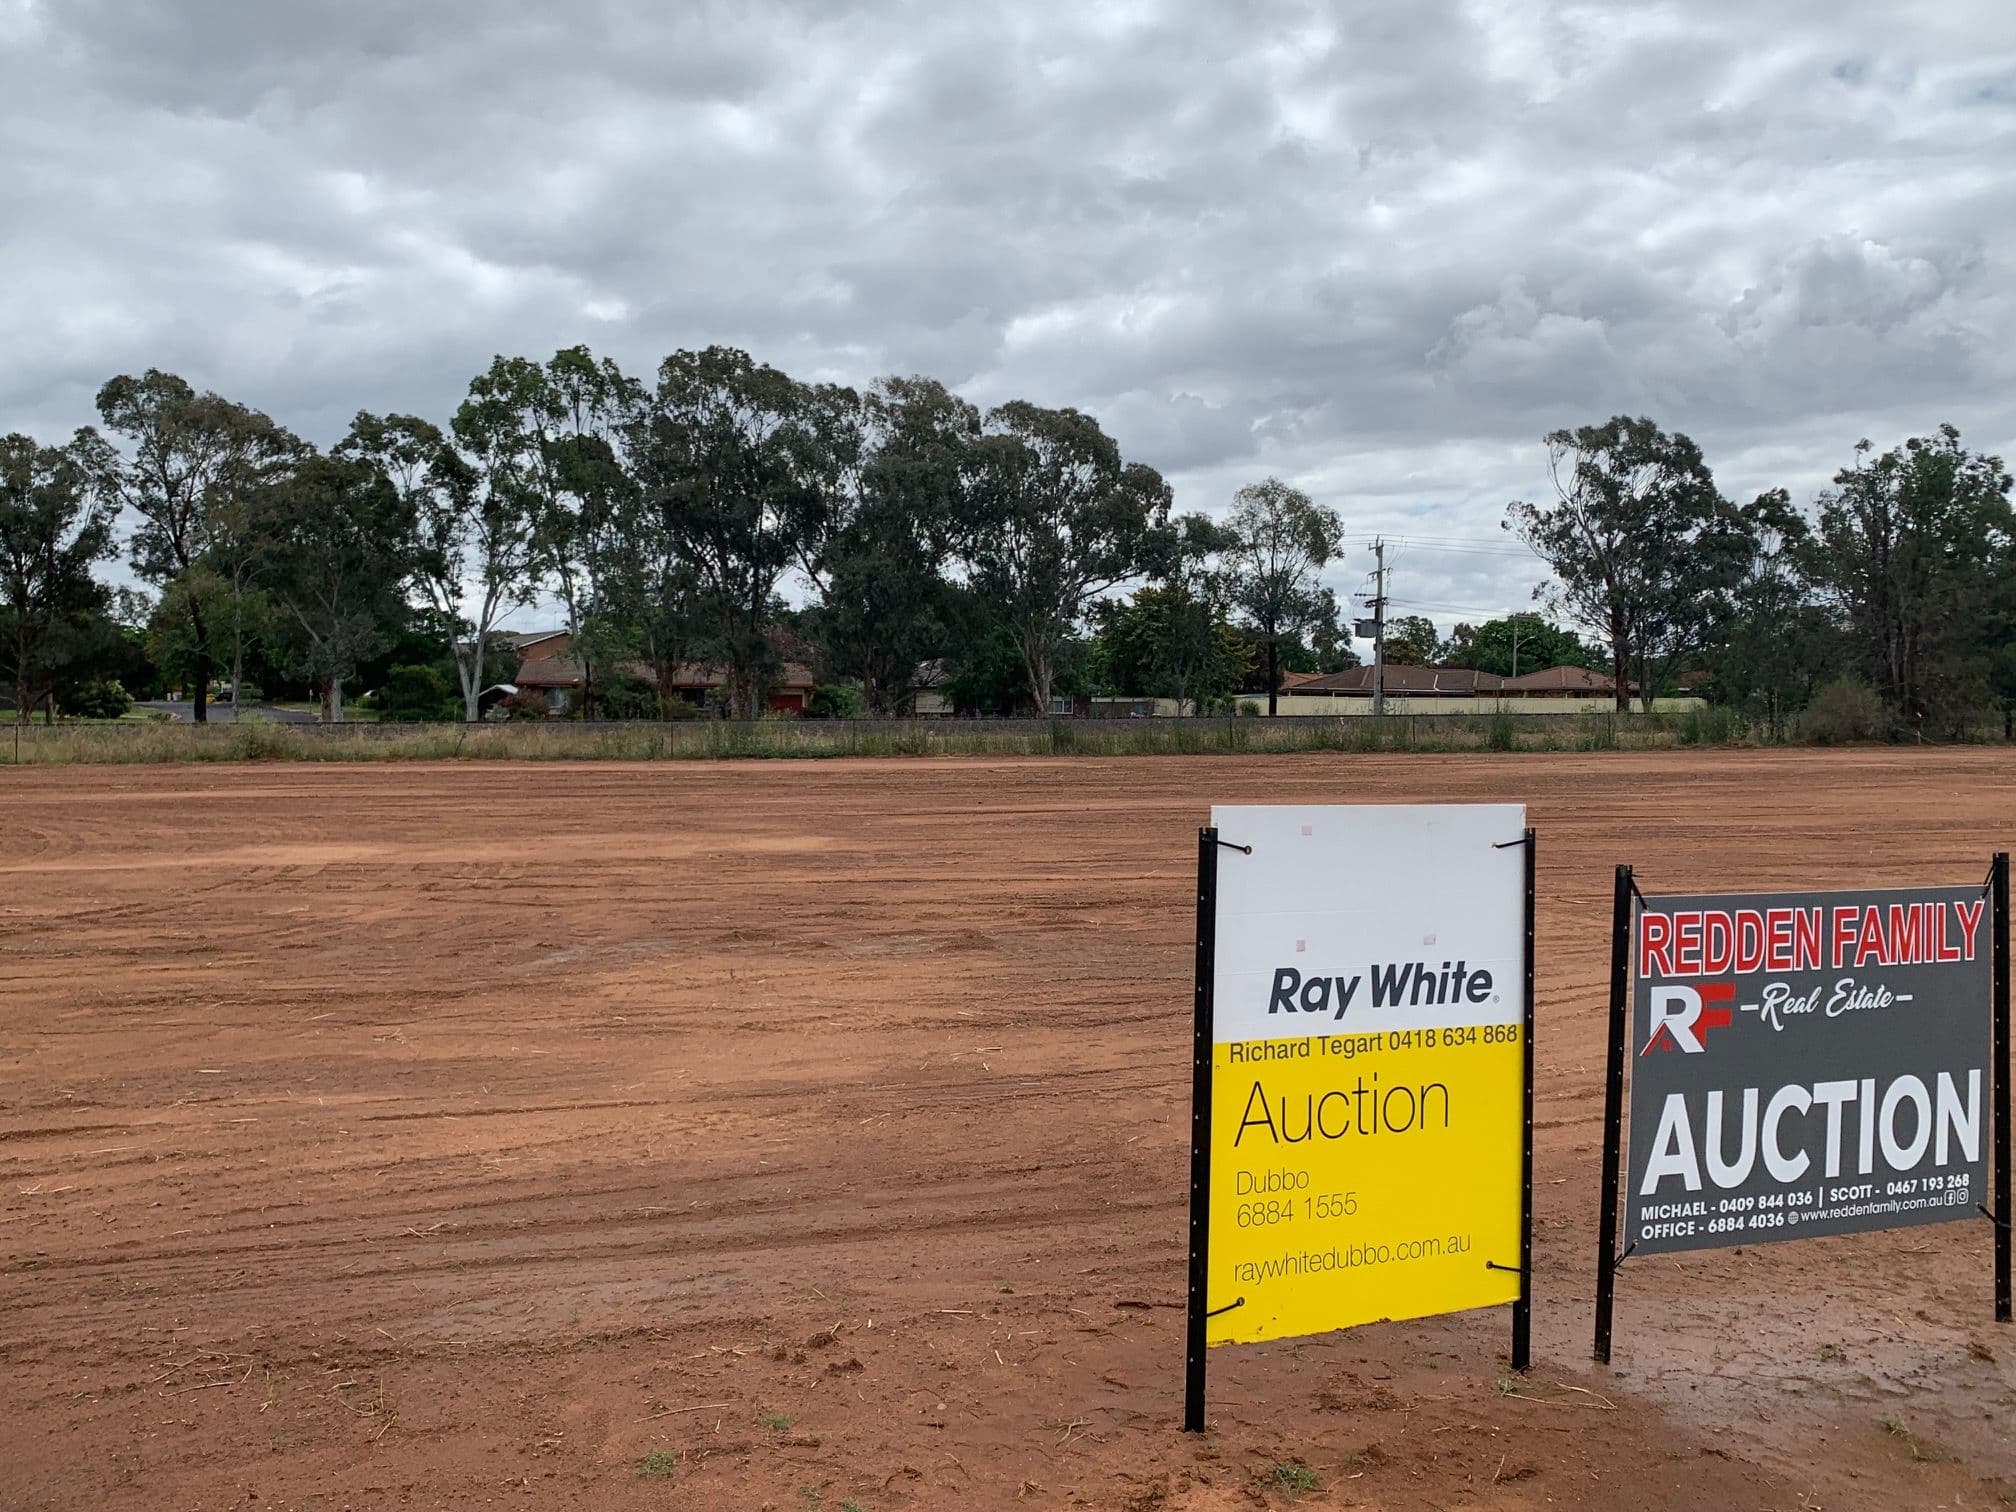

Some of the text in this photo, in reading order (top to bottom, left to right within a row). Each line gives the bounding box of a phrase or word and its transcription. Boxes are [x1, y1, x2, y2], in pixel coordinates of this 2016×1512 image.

[1639, 900, 1985, 979] REDDEN FAMILY
[1268, 961, 1494, 1020] Ray White
[1229, 1025, 1518, 1064] Richard Tegart 0418 634 868
[1233, 1072, 1449, 1147] Auction
[1639, 1069, 1981, 1196] AUCTION
[1236, 1167, 1310, 1196] Dubbo
[1830, 1185, 1872, 1202] SCOTT
[1887, 1179, 1917, 1196] 0467
[1920, 1176, 1944, 1191] 193
[1947, 1173, 1970, 1188] 268
[1237, 1192, 1358, 1228] 6884 1555
[1641, 1203, 1707, 1221] MICHAEL
[1719, 1197, 1754, 1213] 0409
[1758, 1194, 1784, 1209] 844
[1787, 1191, 1813, 1206] 036
[1801, 1195, 1943, 1223] www.reddenfamily.com.au
[1641, 1222, 1695, 1239] OFFICE
[1708, 1216, 1744, 1233] 6884
[1748, 1212, 1784, 1229] 4036
[1234, 1235, 1471, 1286] raywhitedubbo.com.au
